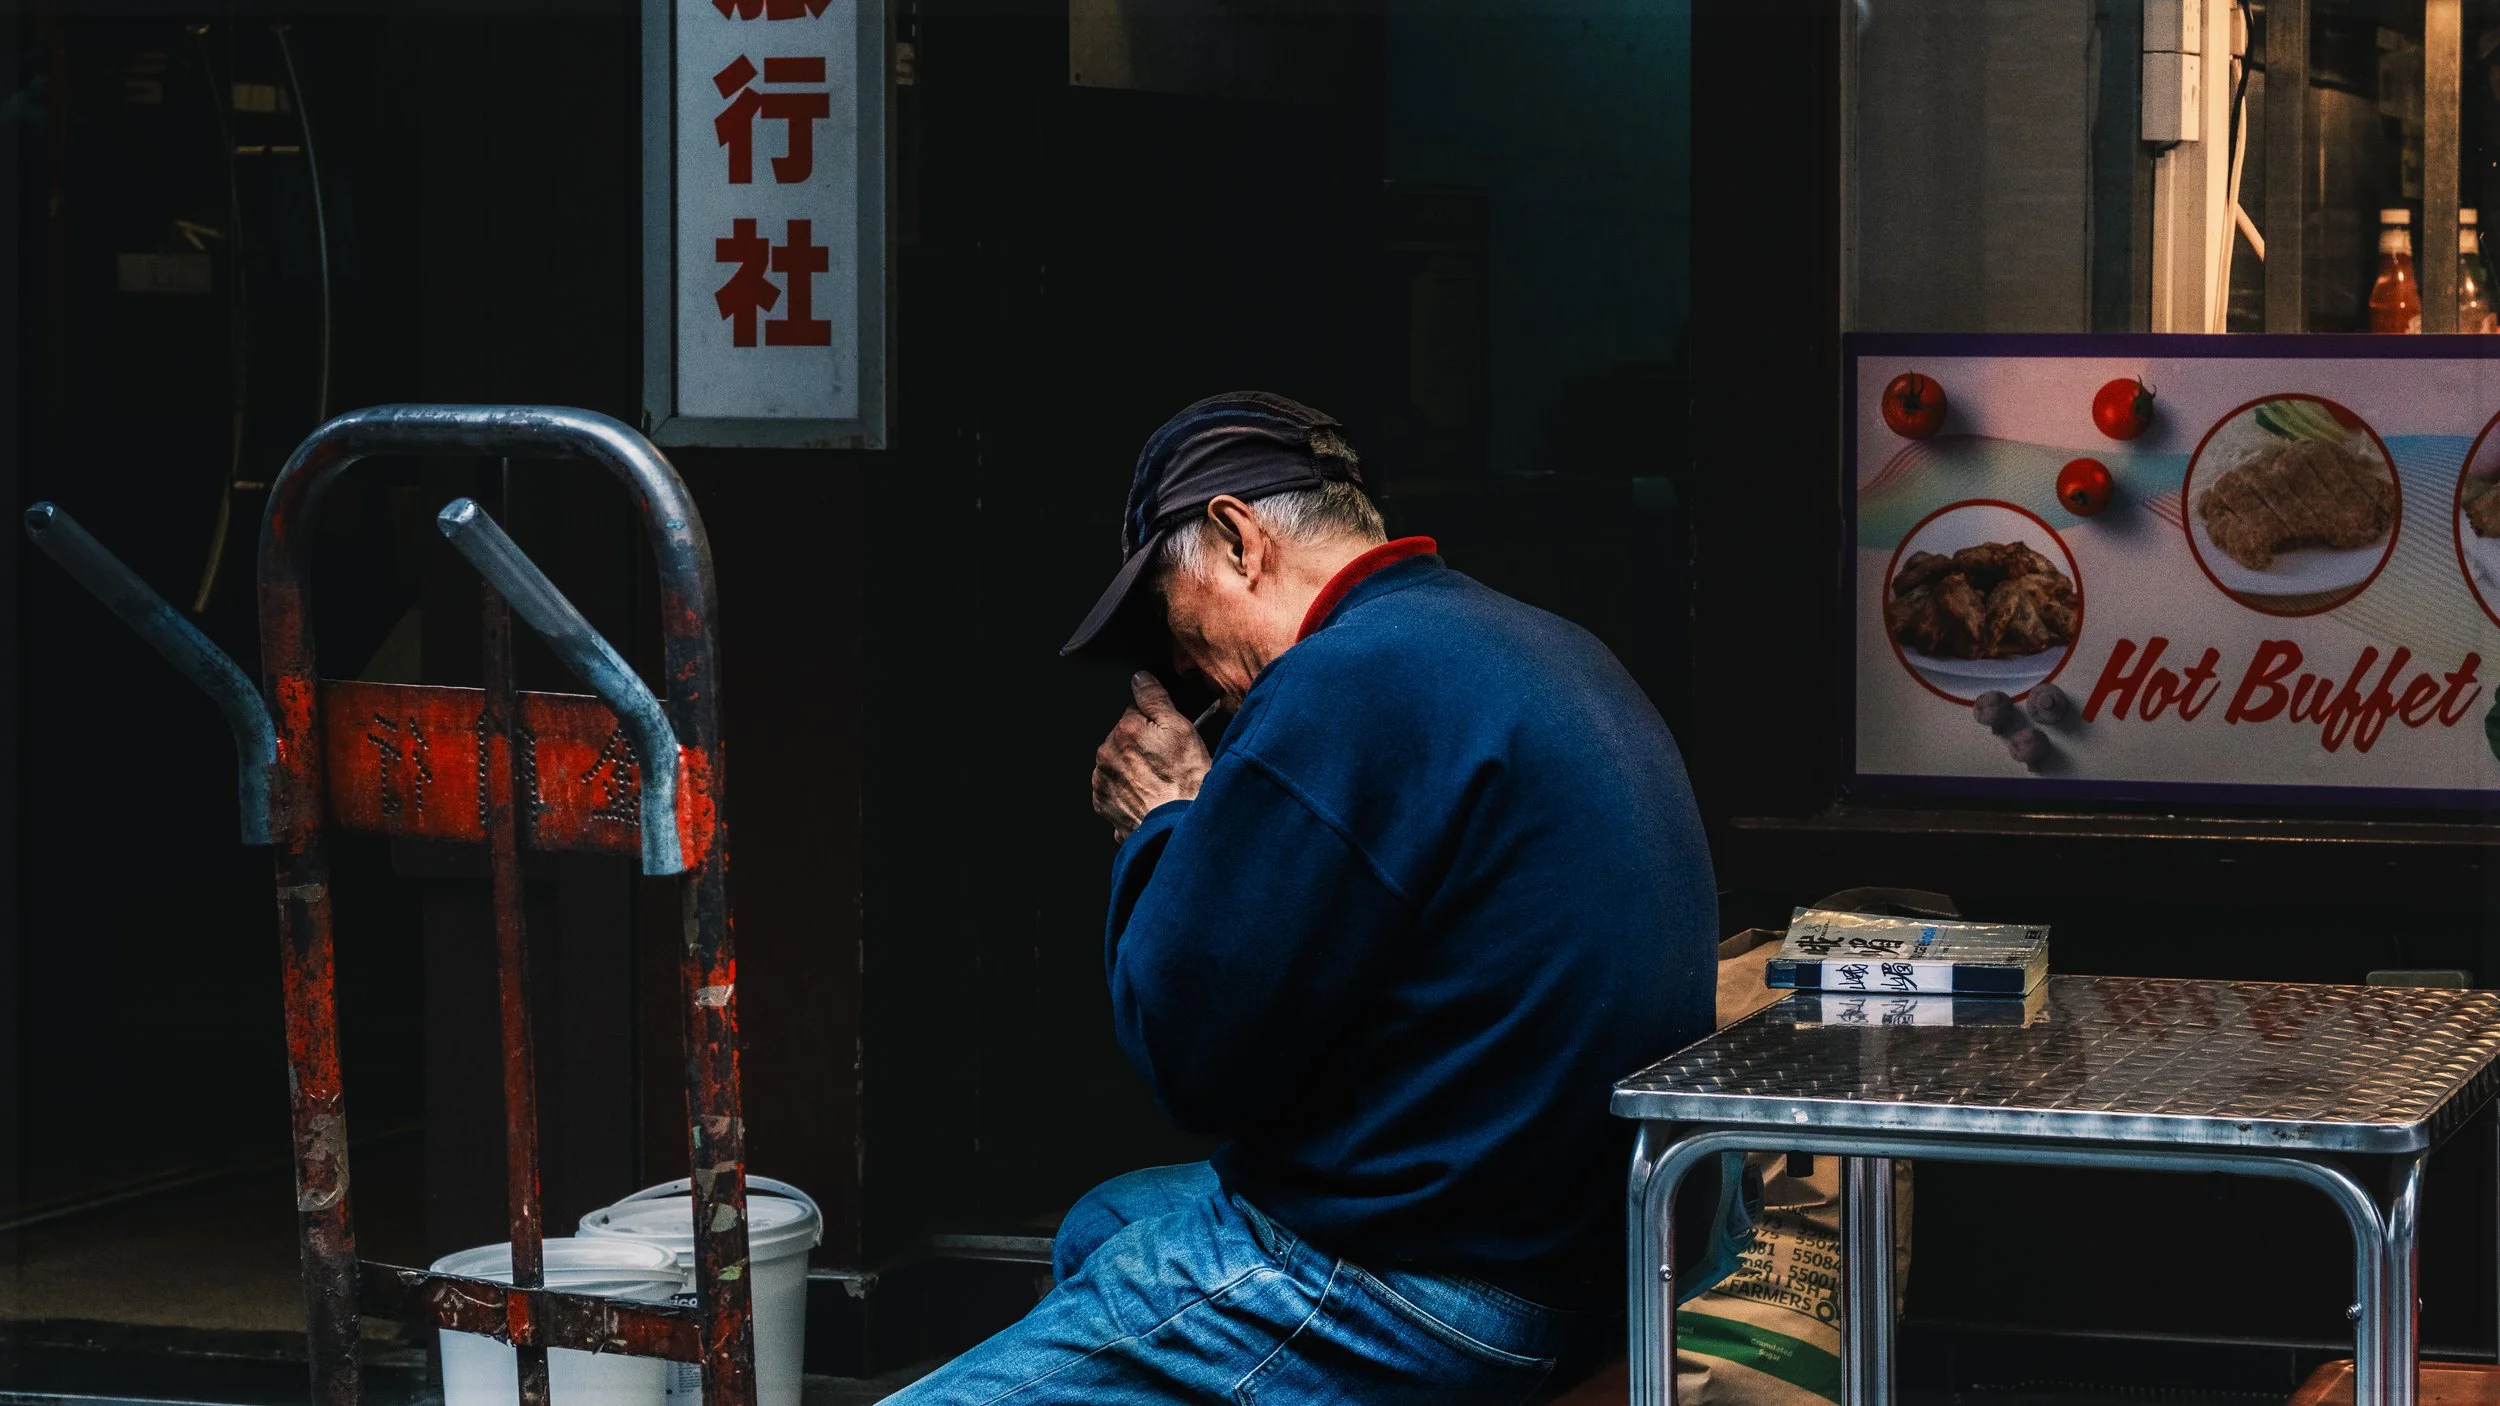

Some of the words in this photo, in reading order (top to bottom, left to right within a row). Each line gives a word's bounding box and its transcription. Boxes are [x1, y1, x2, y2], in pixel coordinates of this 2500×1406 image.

[712, 0, 832, 347] 行社
[2082, 637, 2221, 724] Hot
[2224, 640, 2482, 752] Buffet
[1729, 1279, 1812, 1311] FARMERS
[1758, 1348, 1781, 1362] Sugar
